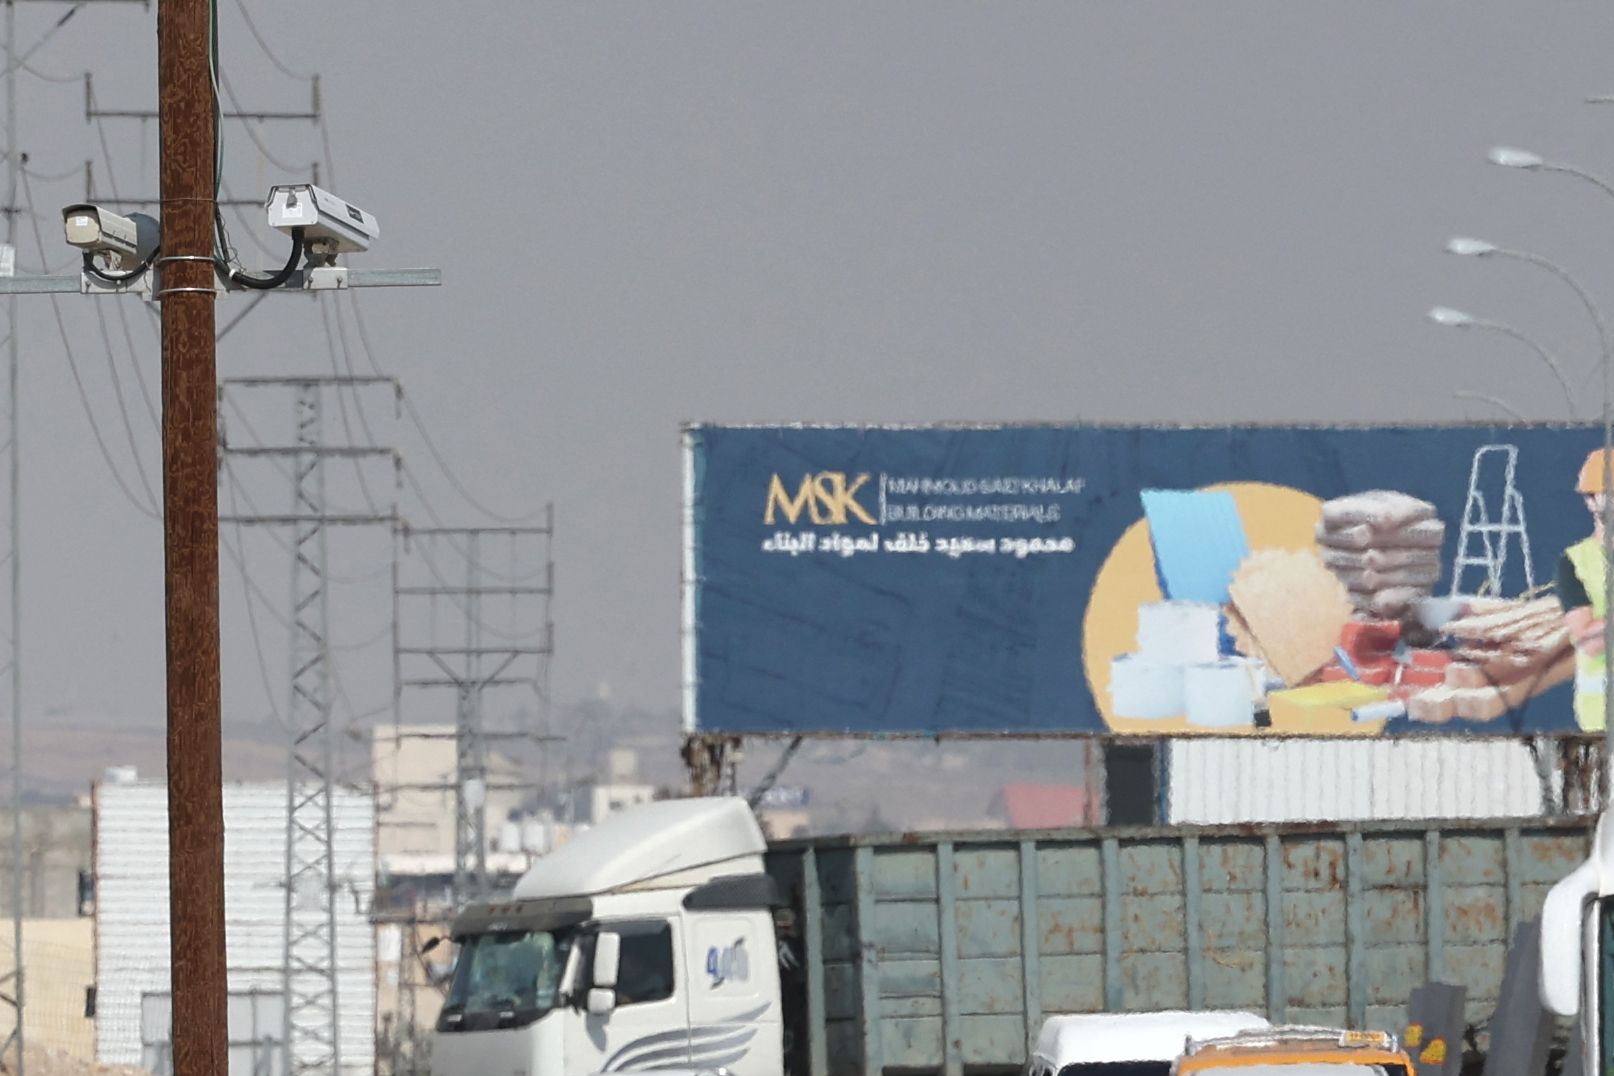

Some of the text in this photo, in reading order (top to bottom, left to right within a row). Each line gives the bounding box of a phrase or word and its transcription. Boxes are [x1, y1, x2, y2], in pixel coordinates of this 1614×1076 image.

[763, 471, 878, 525] MSK
[886, 503, 1061, 524] BUILDING MATERIALS
